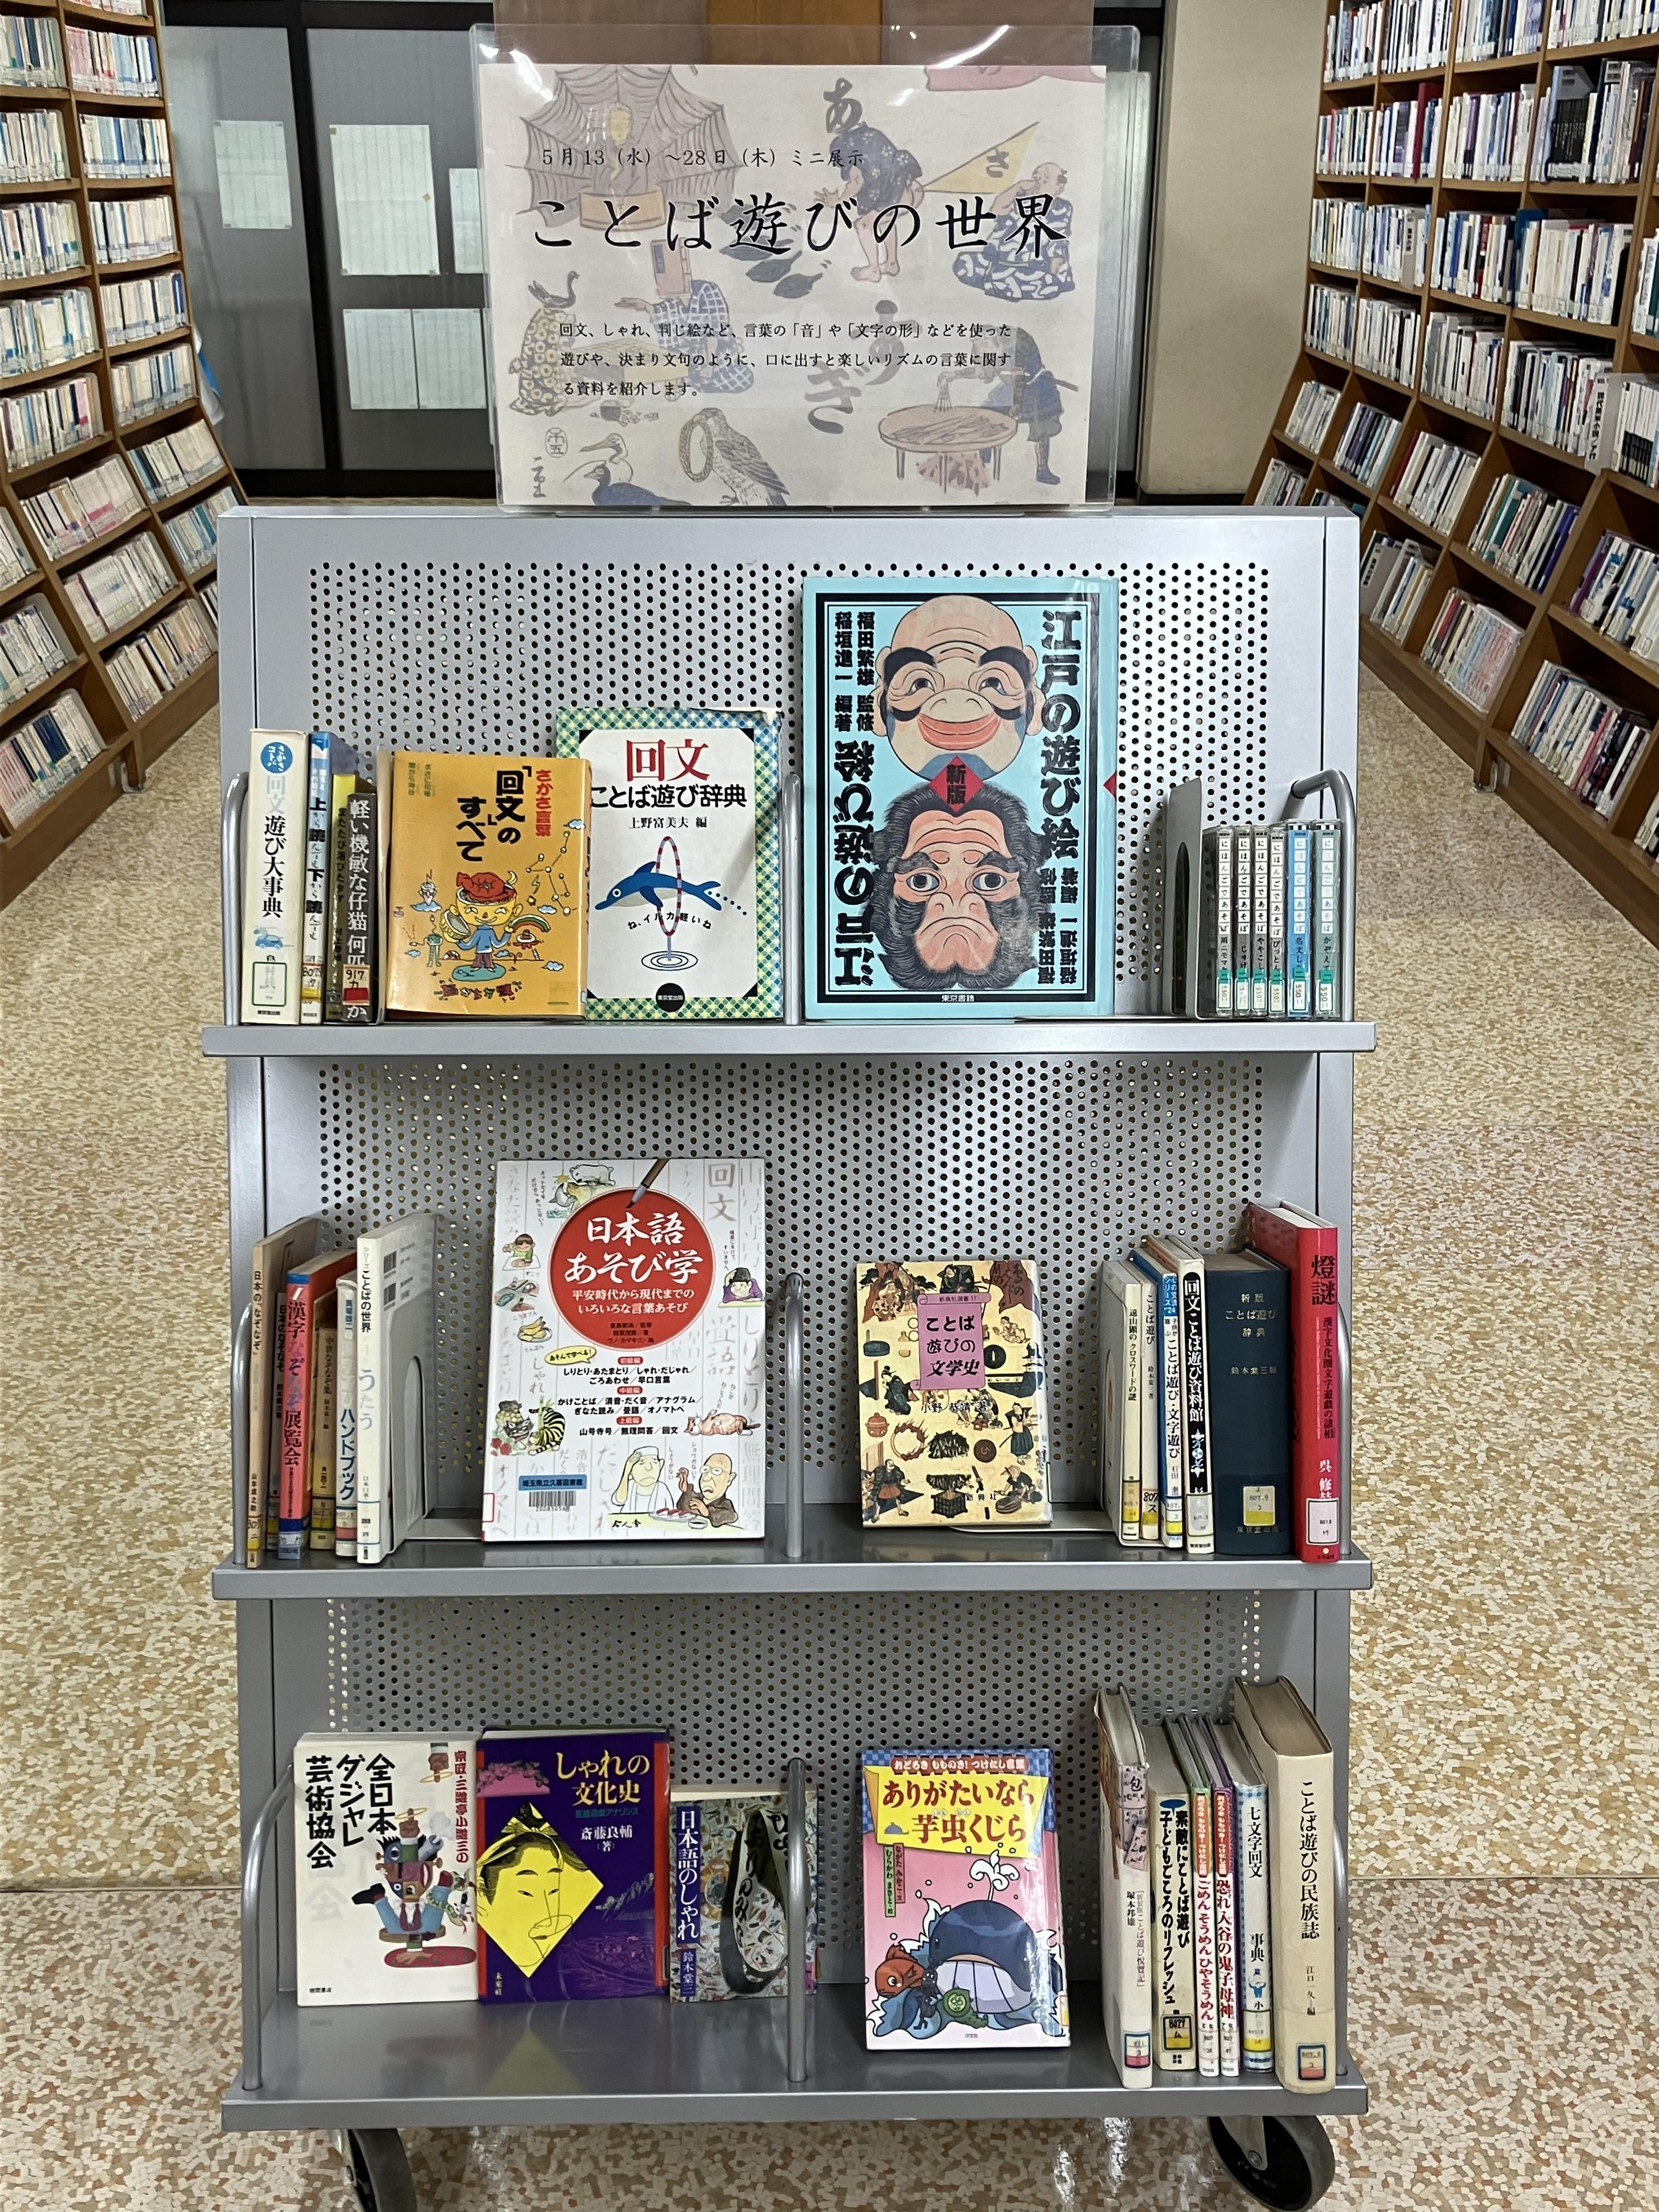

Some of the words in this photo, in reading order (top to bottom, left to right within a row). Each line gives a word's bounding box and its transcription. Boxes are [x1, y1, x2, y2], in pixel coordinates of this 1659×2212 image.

[535, 192, 1066, 258] ことば遊びの世界
[560, 323, 1011, 339] 回文、しゃれ、判じ絵など、言葉の「音」や「文字の形」などを使った
[560, 352, 1011, 368] 遊びや、決まり文句のように、口に出すと楽しいリズムの言葉に関す
[563, 382, 698, 397] る資料を紹介します。
[856, 612, 875, 686] 福田繁雄
[834, 695, 853, 732] 編著
[856, 695, 874, 732] 監修
[1041, 610, 1081, 859] 江戸の遊び絵
[626, 738, 710, 782] 回文
[946, 765, 966, 805] 新版
[488, 766, 532, 845] 「回文」の
[591, 783, 747, 808] ことば遊び辞典
[262, 775, 287, 918] 回文遊び大事典
[456, 797, 487, 862] すべて
[628, 816, 689, 829] 上野富美夫
[348, 799, 371, 932] 軽い機敏な仔猫
[833, 740, 876, 986] 江戸の遊び絵
[1240, 840, 1248, 932] にほんごであそぼ
[1257, 840, 1266, 932] にほんごであそぼ
[1295, 840, 1304, 932] にほんごであそぼ
[1323, 840, 1332, 932] にほんごであそぼ
[1273, 844, 1281, 936] にほんごであそぼ
[346, 969, 365, 980] 917
[1295, 936, 1304, 968] 名文し
[707, 1163, 738, 1222] 回文
[587, 1211, 686, 1246] 日本語
[564, 1249, 704, 1284] あそび学
[1311, 1255, 1336, 1305] 燈謎
[572, 1289, 695, 1301] 平安時代から現代までの
[578, 1302, 688, 1314] いろいろな言葉あそび
[1146, 1295, 1155, 1345] ことば遊び
[1225, 1310, 1276, 1320] ことば遊び
[1241, 1293, 1264, 1303] 新版
[926, 1315, 975, 1332] ことば
[927, 1338, 975, 1354] 遊びの
[1242, 1327, 1266, 1338] 辞典
[927, 1359, 980, 1378] 文学史
[1184, 1279, 1204, 1422] 回文ことば遊び資料館
[359, 1369, 375, 1431] うたう
[1166, 1340, 1181, 1459] ことば遊び・文字遊び
[1323, 1317, 1335, 1439] 漢字文化圏文字遊戯の諸相
[339, 1408, 357, 1500] ハンドブック
[556, 1750, 651, 1779] しゃれの
[305, 1755, 337, 1869] 芸術協会
[336, 1754, 365, 1847] ダジャレ
[365, 1753, 397, 1835] 全日本
[572, 1780, 641, 1806] 文化史
[883, 1779, 1035, 1808] ありがたいなら
[912, 1814, 1026, 1844] 芋虫くじら
[1247, 1807, 1262, 1878] 七文字回文
[677, 1811, 699, 1940] 日本語のしゃれ
[1175, 1810, 1190, 1948] 素敵にことば遊び
[1299, 1781, 1319, 1940] ことば遊びの民族誌
[1159, 1811, 1176, 2004] 子どもごころのリフレッシュ
[1198, 1880, 1211, 1910] ごめん
[1199, 1913, 1212, 1955] そうめん
[1250, 1933, 1265, 1962] 事典
[1200, 1958, 1214, 2021] ひやそうめん
